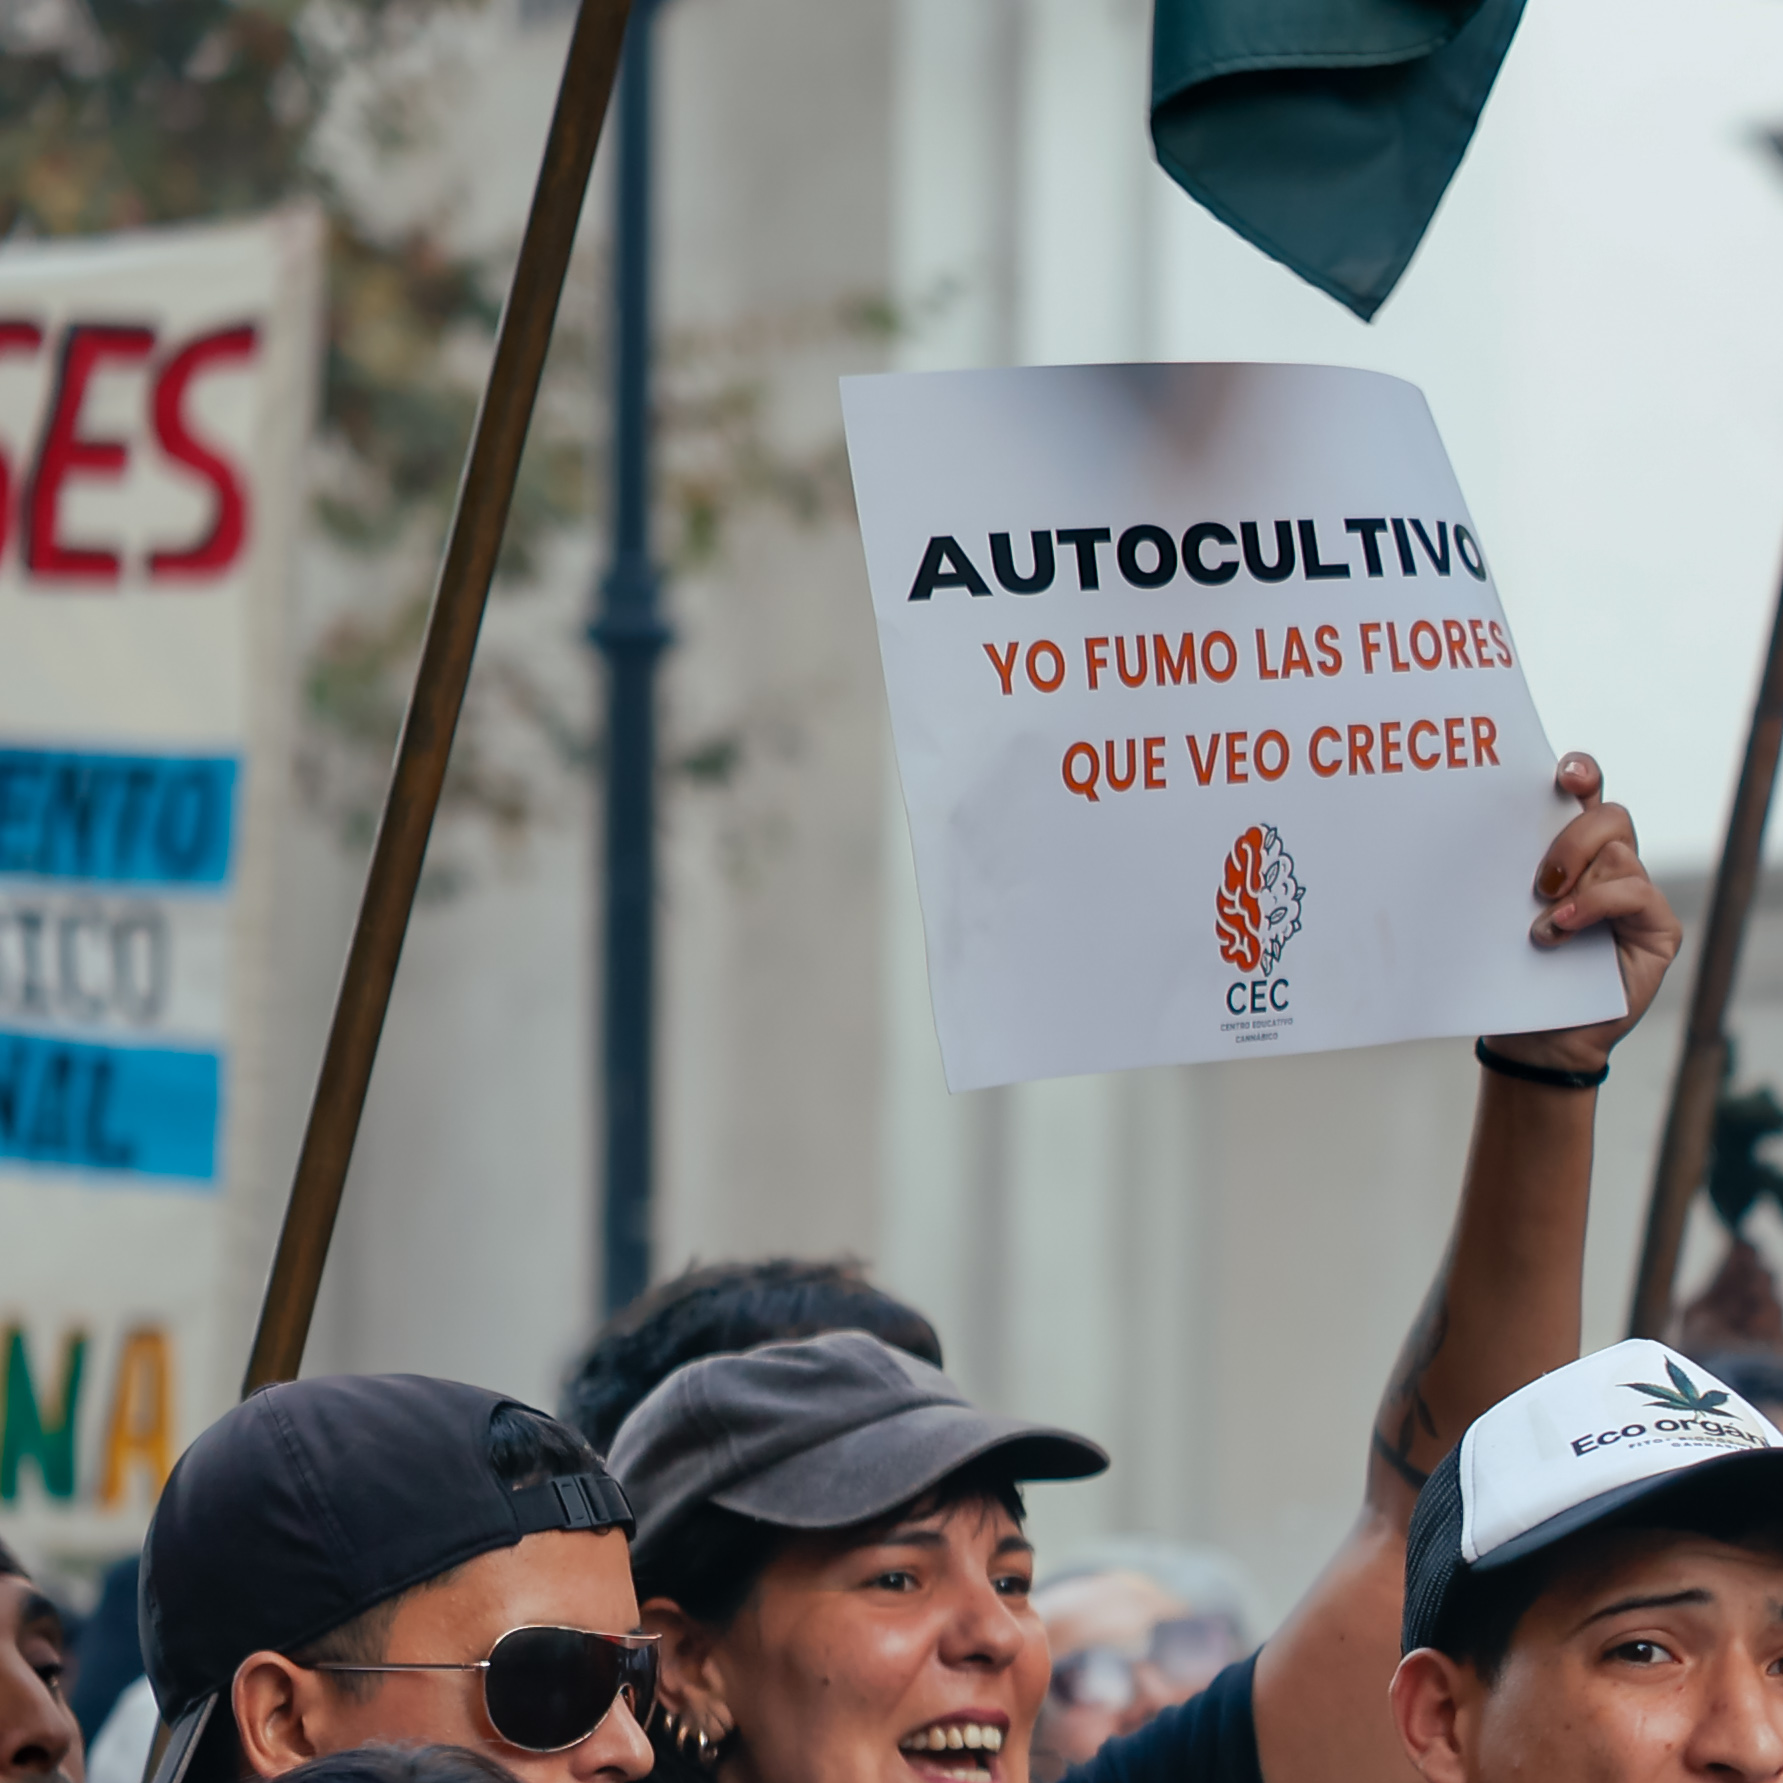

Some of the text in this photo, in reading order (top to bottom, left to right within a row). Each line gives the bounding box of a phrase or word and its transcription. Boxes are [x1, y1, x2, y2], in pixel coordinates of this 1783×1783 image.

[0, 318, 260, 585] ES
[908, 517, 1486, 601] AUTOCULTIVO
[983, 618, 1513, 696] YO FUMO LAS FLORES
[1062, 715, 1500, 802] QUE VEO CRECER
[0, 900, 168, 1024] ICO
[1226, 978, 1289, 1016] CEC
[1220, 1018, 1293, 1032] CENTRO EDUCATIVO
[1570, 1423, 1647, 1457] Eco
